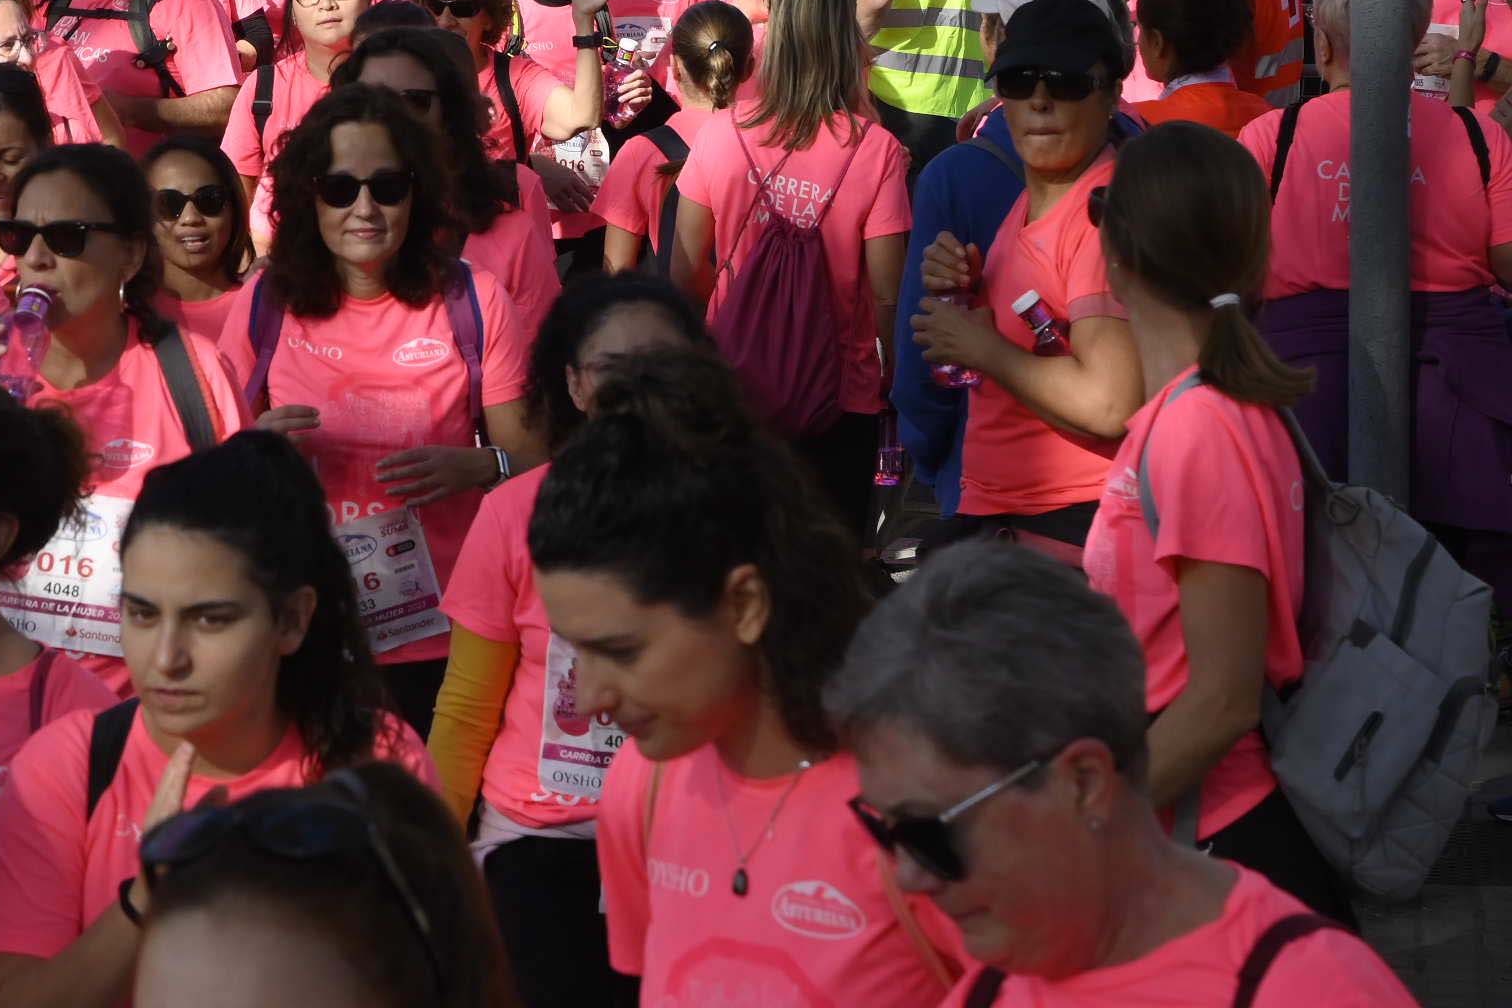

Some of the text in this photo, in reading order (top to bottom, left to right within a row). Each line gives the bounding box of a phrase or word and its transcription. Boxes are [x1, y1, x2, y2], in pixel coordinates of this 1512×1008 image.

[746, 167, 835, 209] CARRERA
[791, 196, 817, 216] LA
[38, 551, 95, 578] 016
[43, 582, 80, 598] 4048
[56, 604, 70, 613] LA
[71, 606, 105, 619] MUJER
[552, 770, 602, 789] OYSHO
